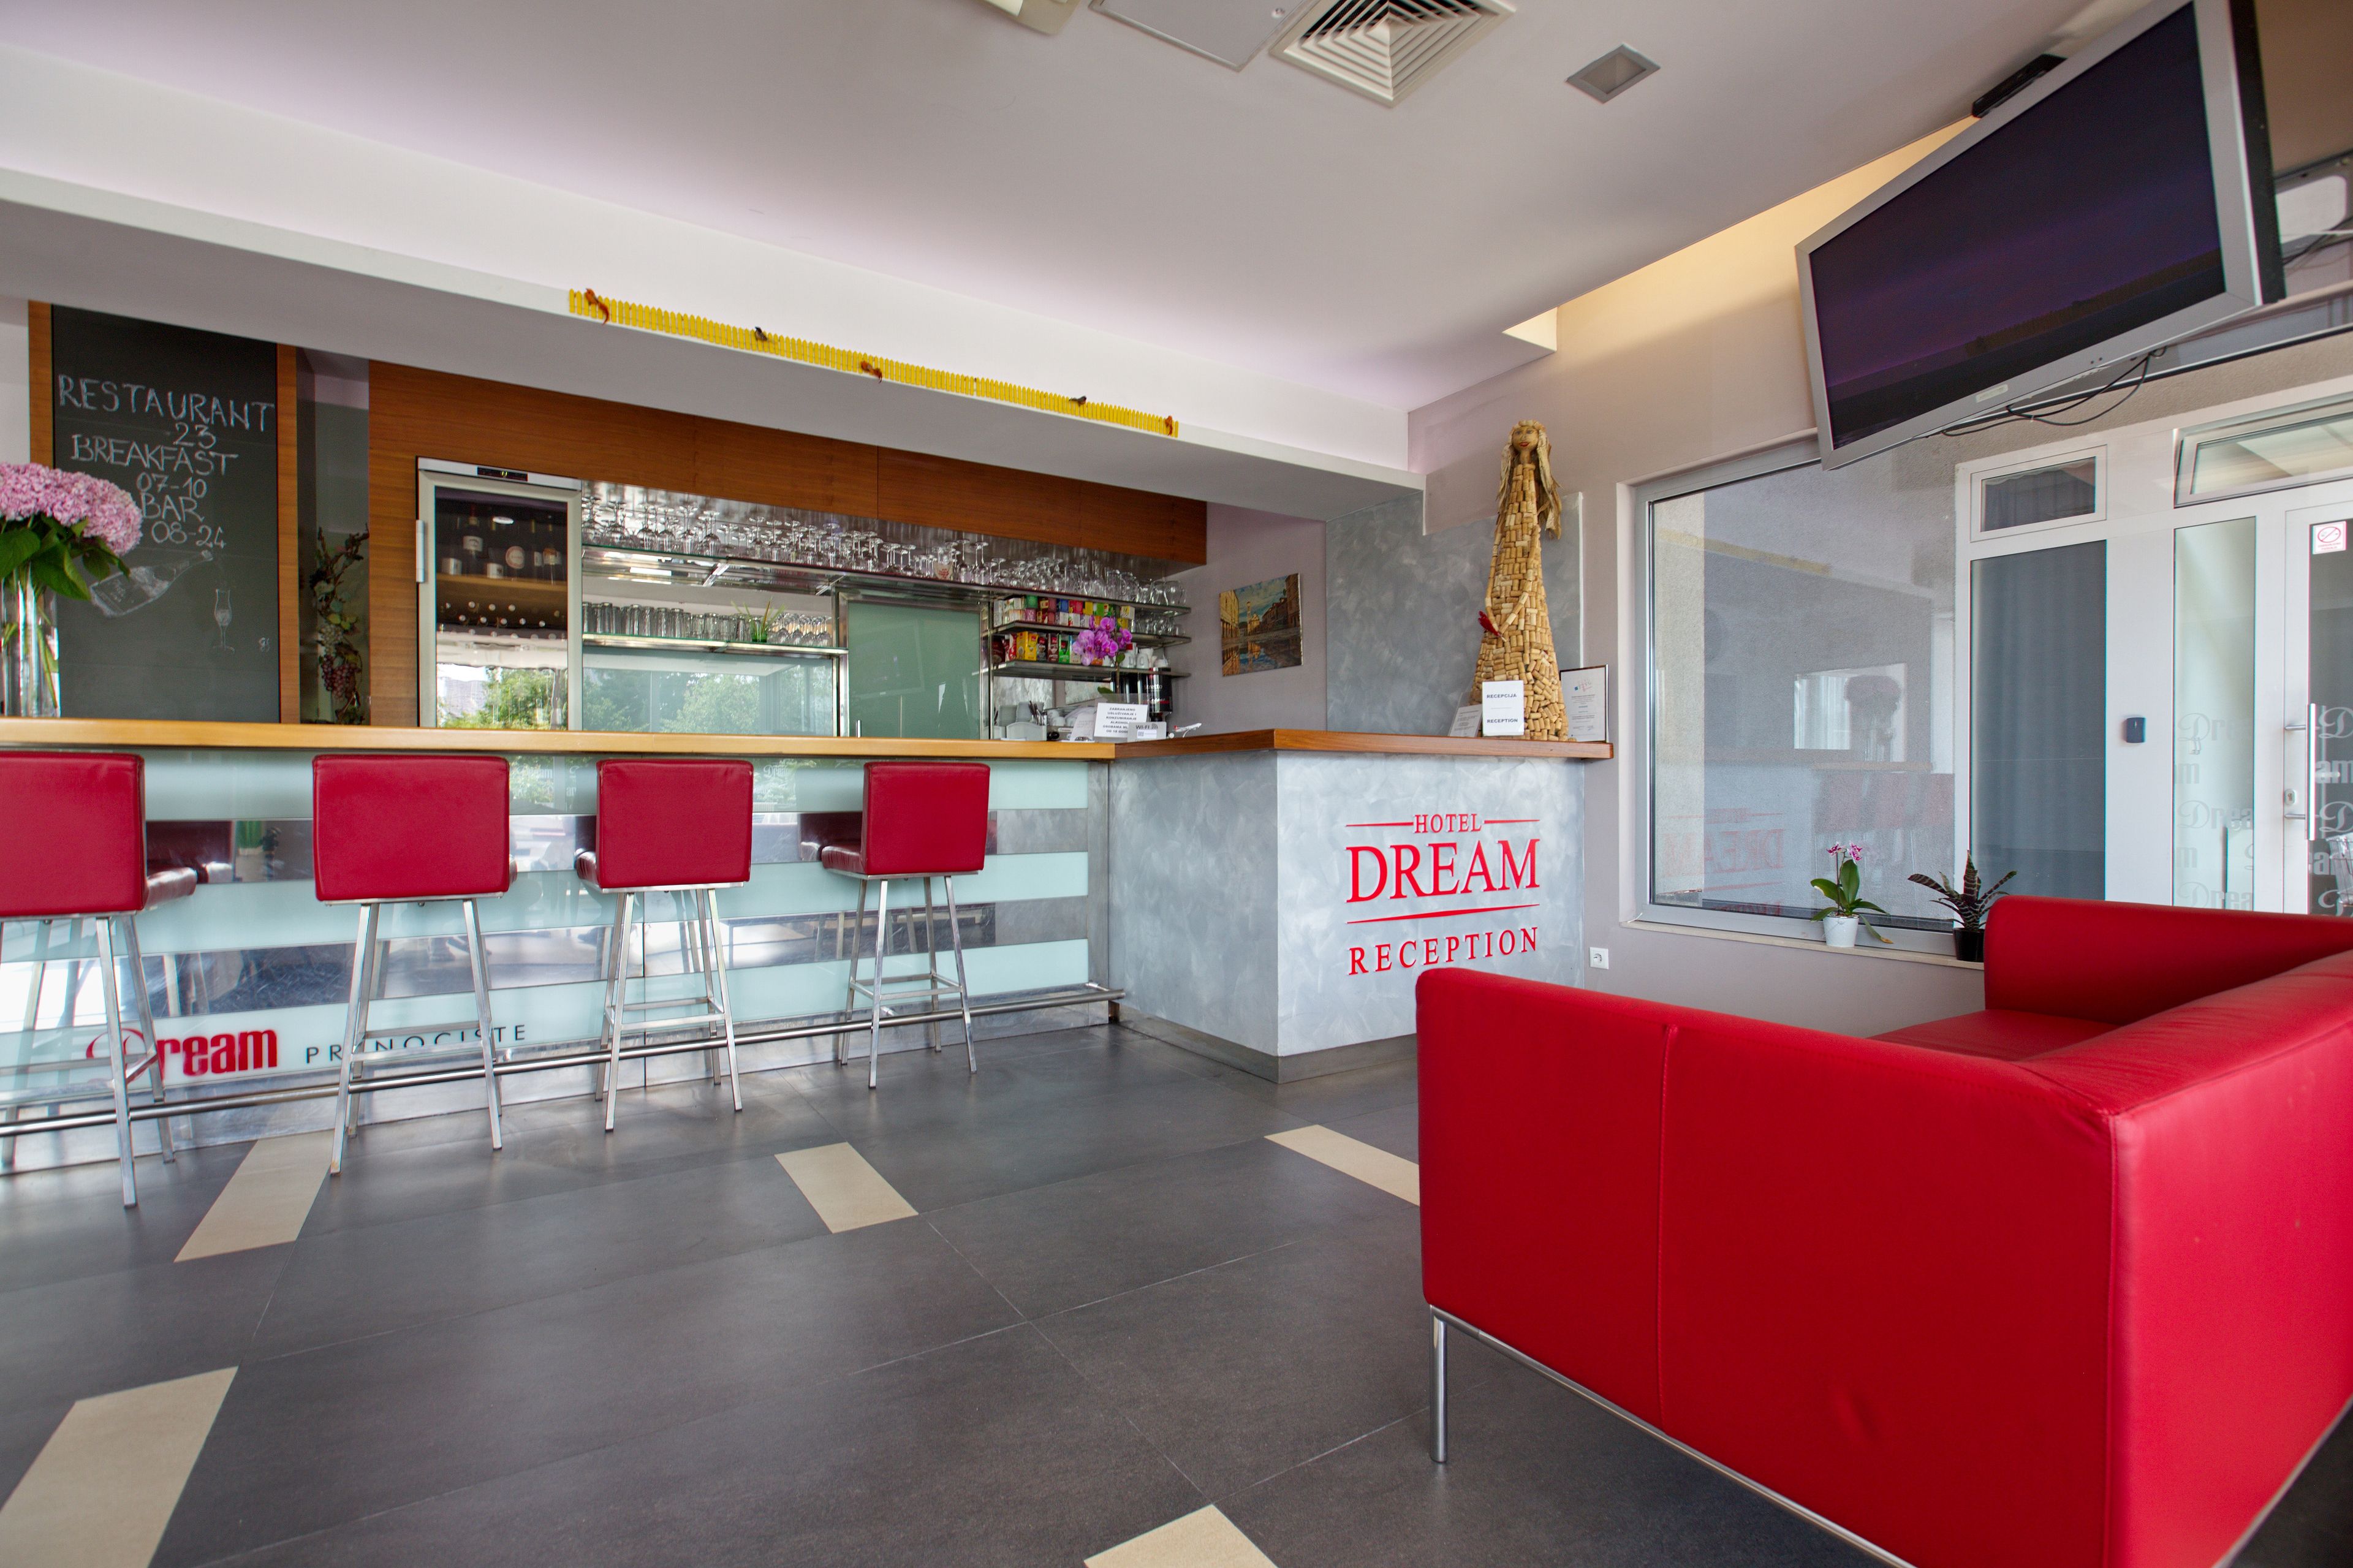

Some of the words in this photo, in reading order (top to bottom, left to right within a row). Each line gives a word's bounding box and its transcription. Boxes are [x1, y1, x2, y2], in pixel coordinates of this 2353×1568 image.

[58, 374, 275, 432] RESTAURANT
[70, 434, 239, 477] BREAKFAST
[136, 472, 208, 499] 07-10
[140, 491, 205, 523] BAR
[152, 521, 226, 549] 08-24
[1414, 814, 1482, 833] HOTEL
[1346, 839, 1540, 903] DREAM
[1349, 926, 1538, 975] RECEPTION
